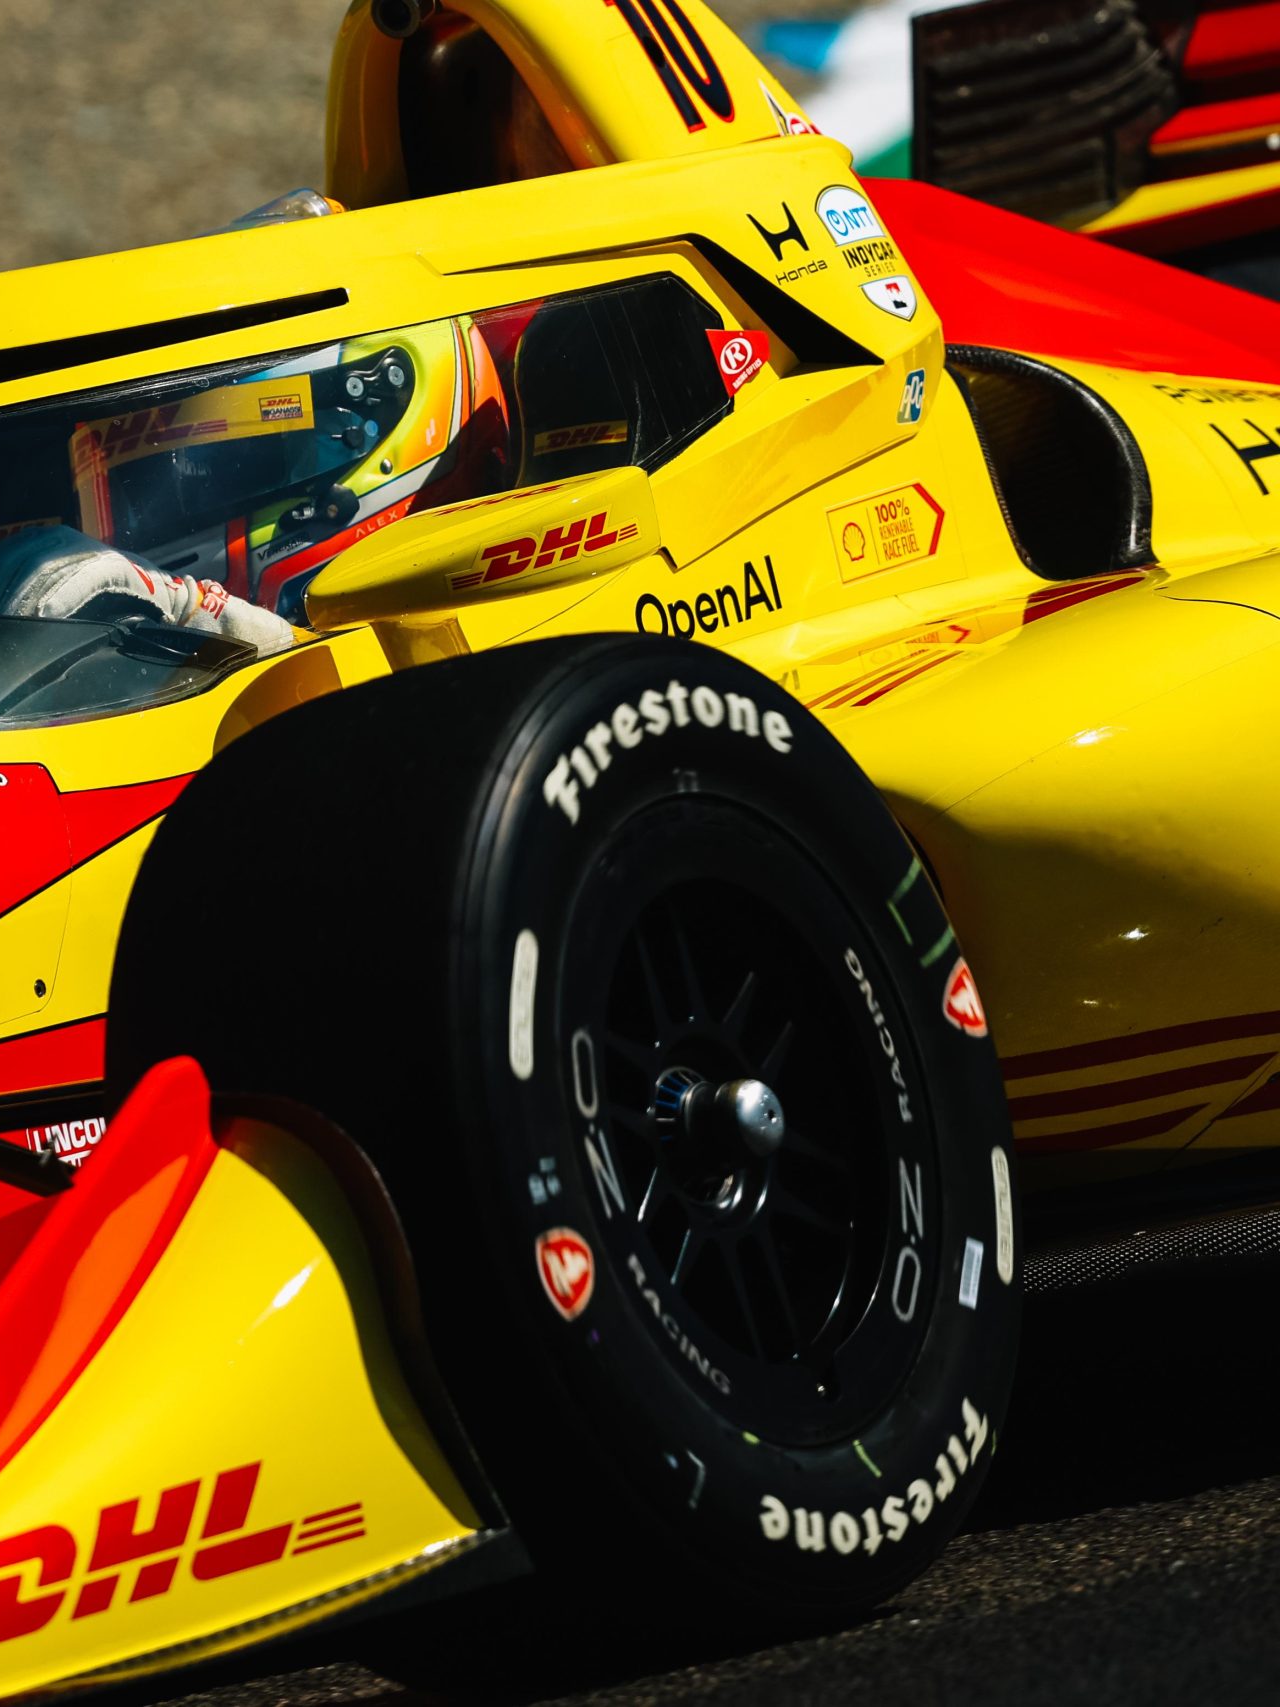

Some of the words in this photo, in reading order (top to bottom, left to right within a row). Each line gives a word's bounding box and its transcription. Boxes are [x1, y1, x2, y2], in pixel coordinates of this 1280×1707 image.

[604, 0, 735, 134] 10
[843, 206, 874, 230] NTT
[842, 241, 897, 269] INDYCAR
[776, 259, 828, 285] Honda
[865, 261, 896, 277] SERIES
[547, 425, 611, 449] DHL
[875, 498, 910, 523] 100%
[355, 511, 398, 538] ALEX
[878, 517, 914, 540] RENEWABLE
[481, 511, 619, 583] DHL
[882, 536, 902, 561] RACE
[902, 533, 920, 556] FUEL
[635, 555, 783, 639] OpenAI
[543, 680, 793, 826] Firestone
[760, 1396, 989, 1557] Firestone
